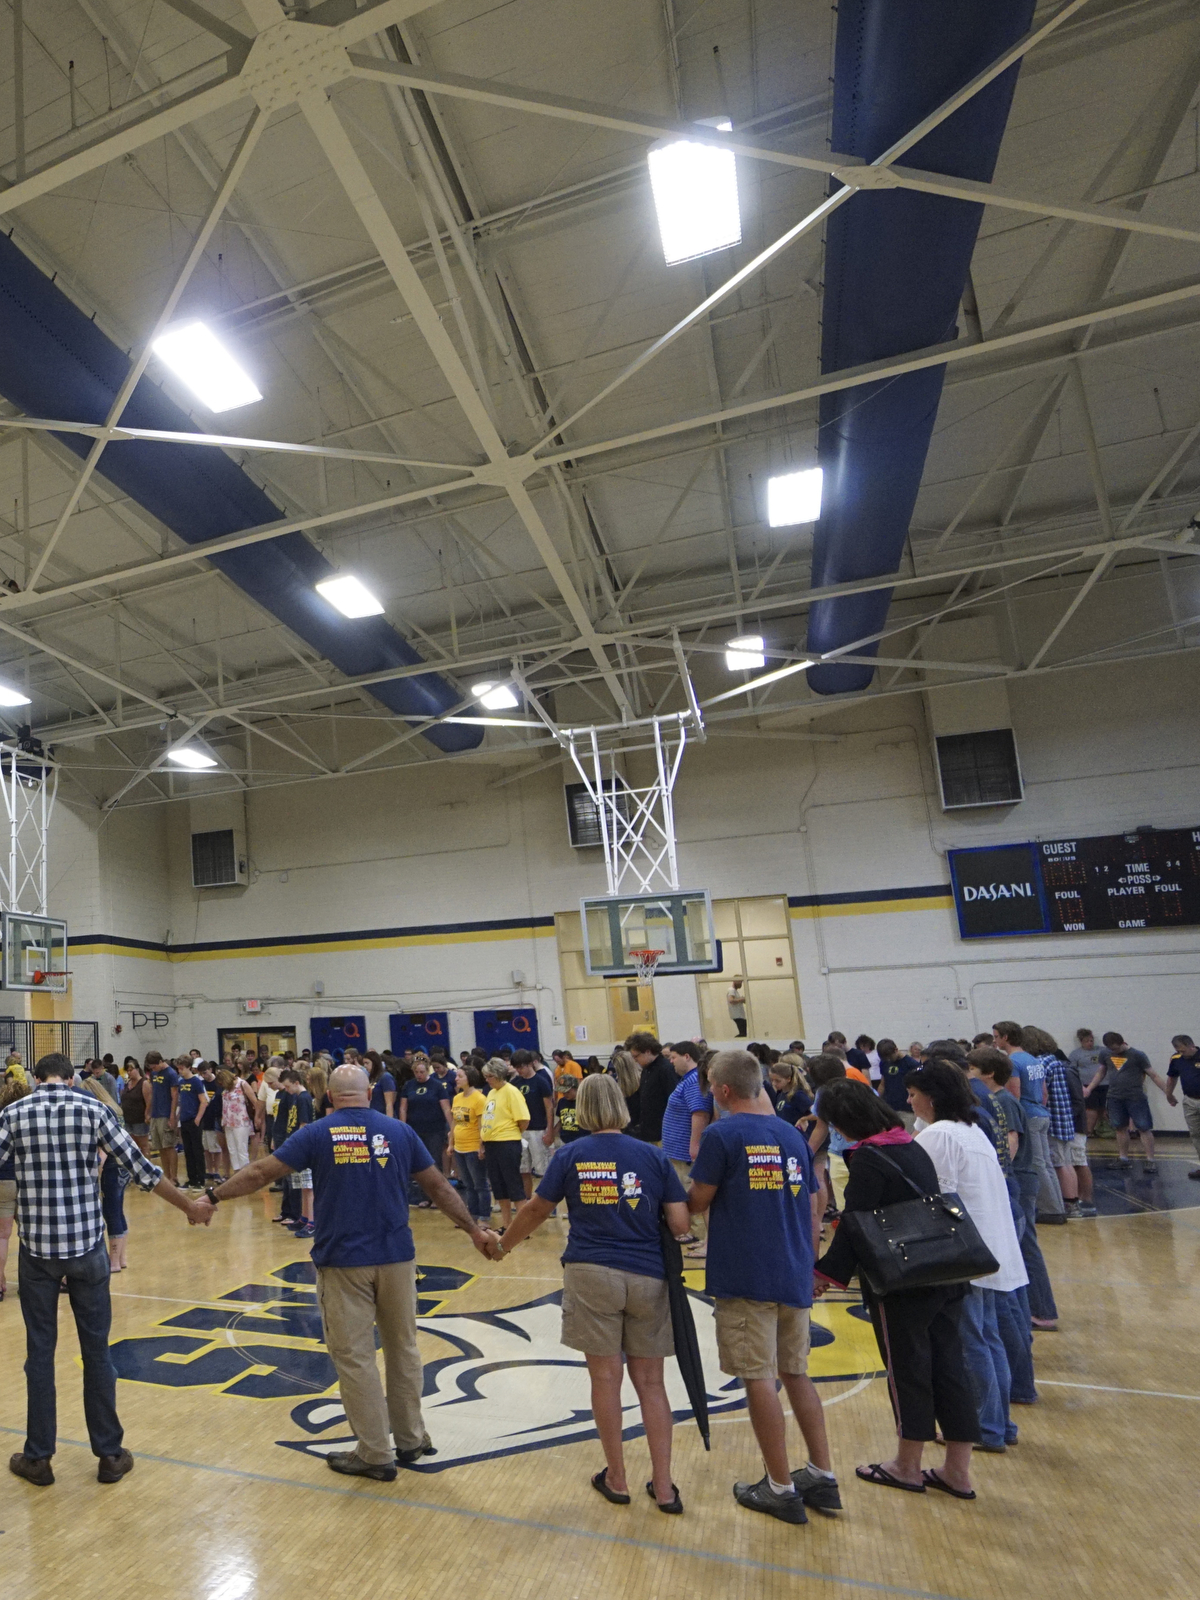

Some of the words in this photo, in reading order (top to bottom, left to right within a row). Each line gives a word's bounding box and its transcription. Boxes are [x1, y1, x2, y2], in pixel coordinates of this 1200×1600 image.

[1043, 842, 1076, 854] GUEST
[1125, 863, 1150, 873] TIME
[1127, 874, 1152, 884] POSS
[1107, 886, 1145, 896] PLAYER
[1155, 884, 1182, 892] FOUL
[1055, 891, 1080, 899] FOUL
[1064, 923, 1085, 931] WON
[1119, 920, 1146, 928] GAME
[578, 1171, 617, 1179] SHUFFLE
